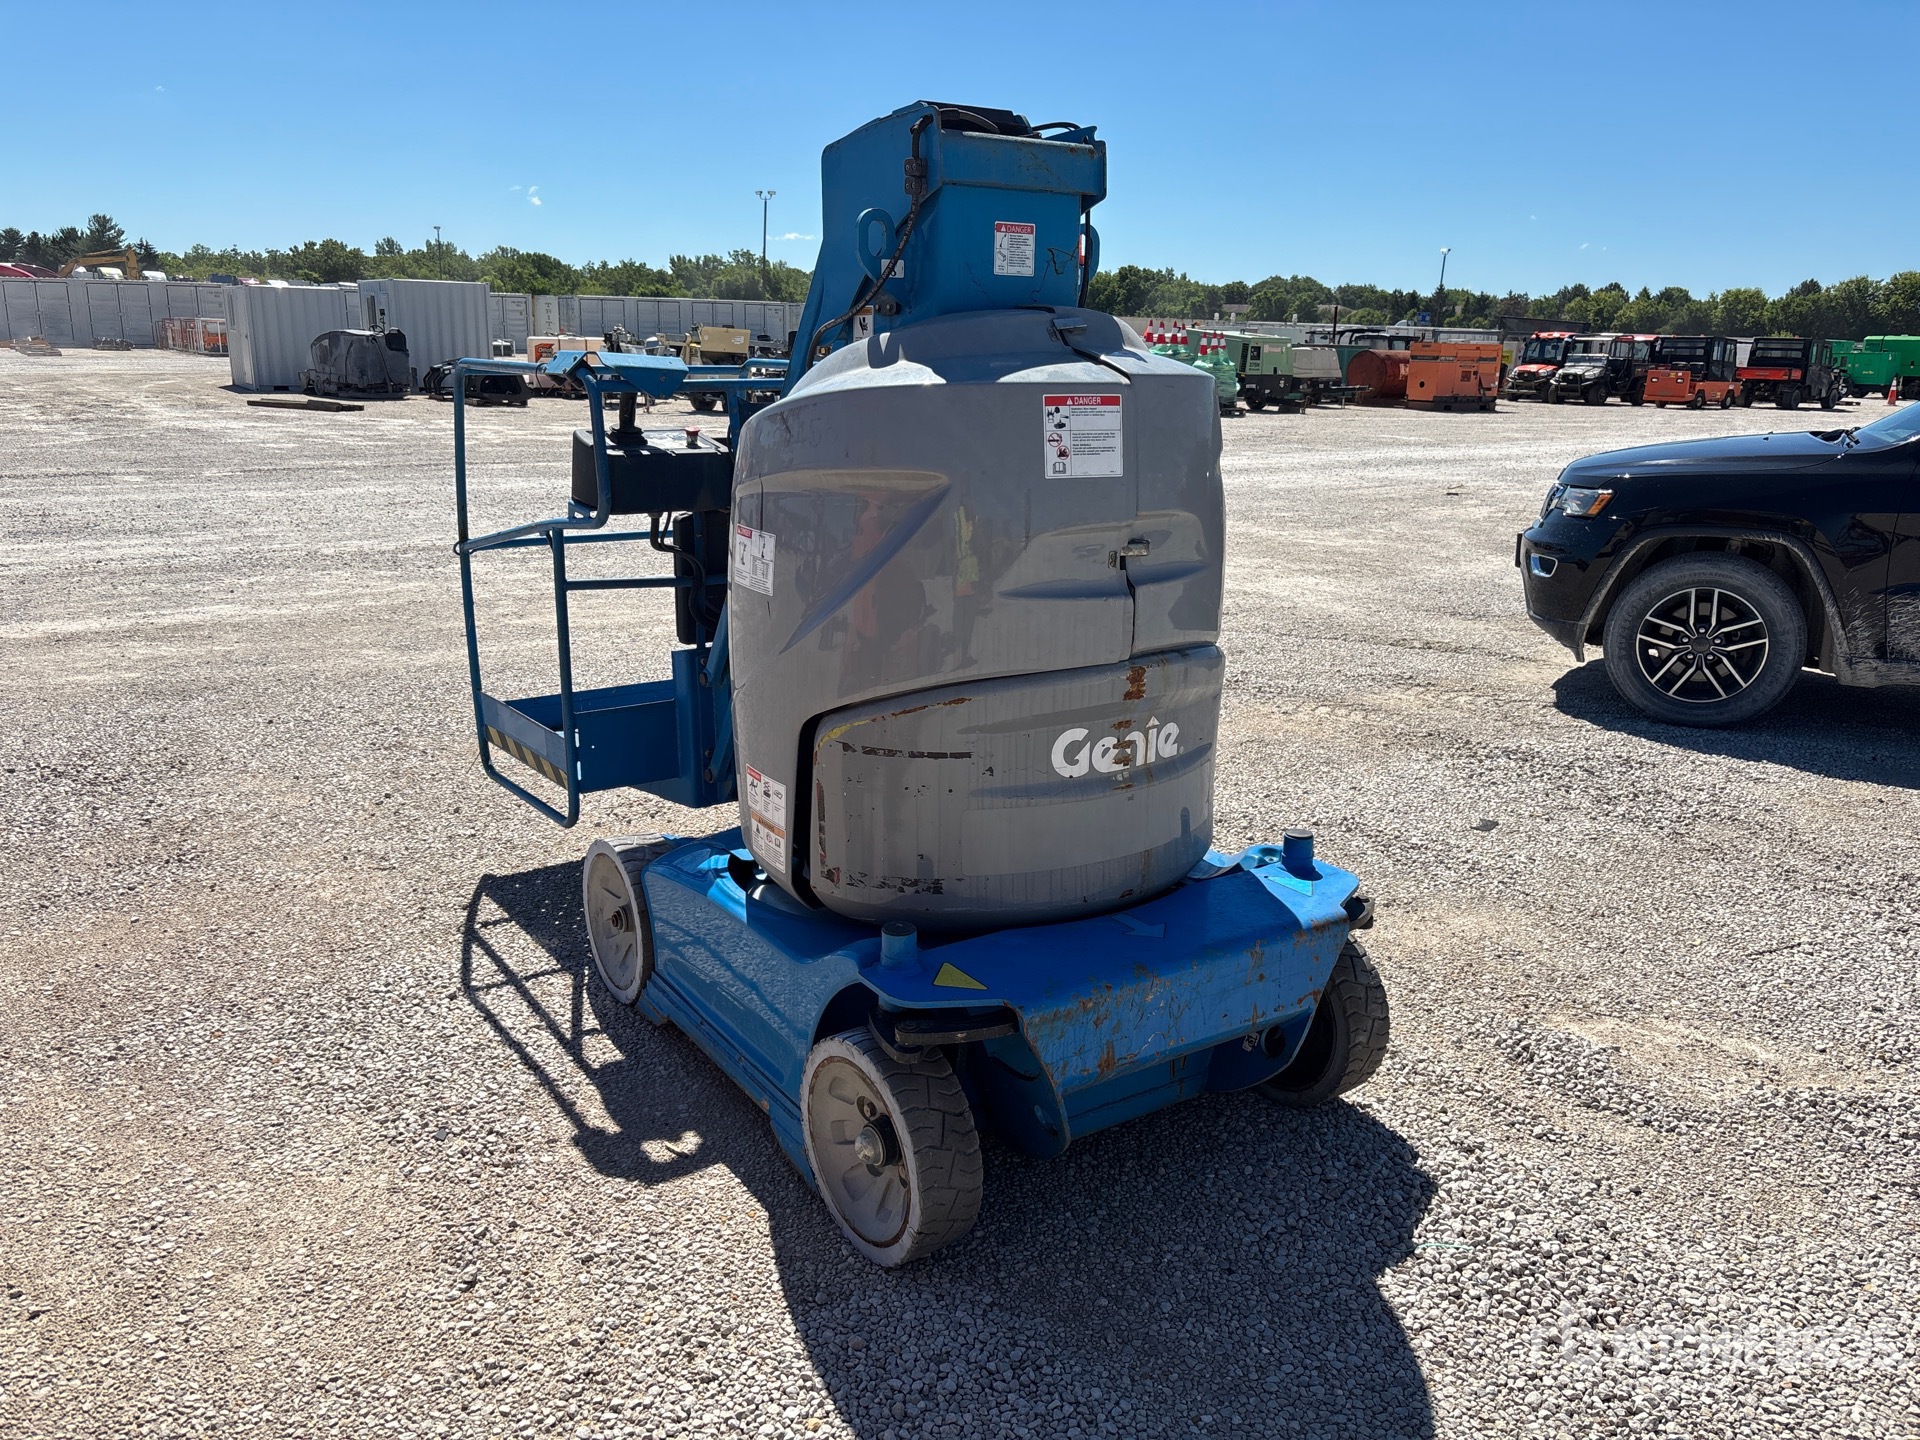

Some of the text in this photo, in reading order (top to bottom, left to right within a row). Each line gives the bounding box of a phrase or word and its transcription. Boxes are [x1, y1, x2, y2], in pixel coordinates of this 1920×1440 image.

[1006, 225, 1032, 233] DANGER
[1074, 396, 1102, 405] DANGER
[1051, 715, 1180, 778] Genie
